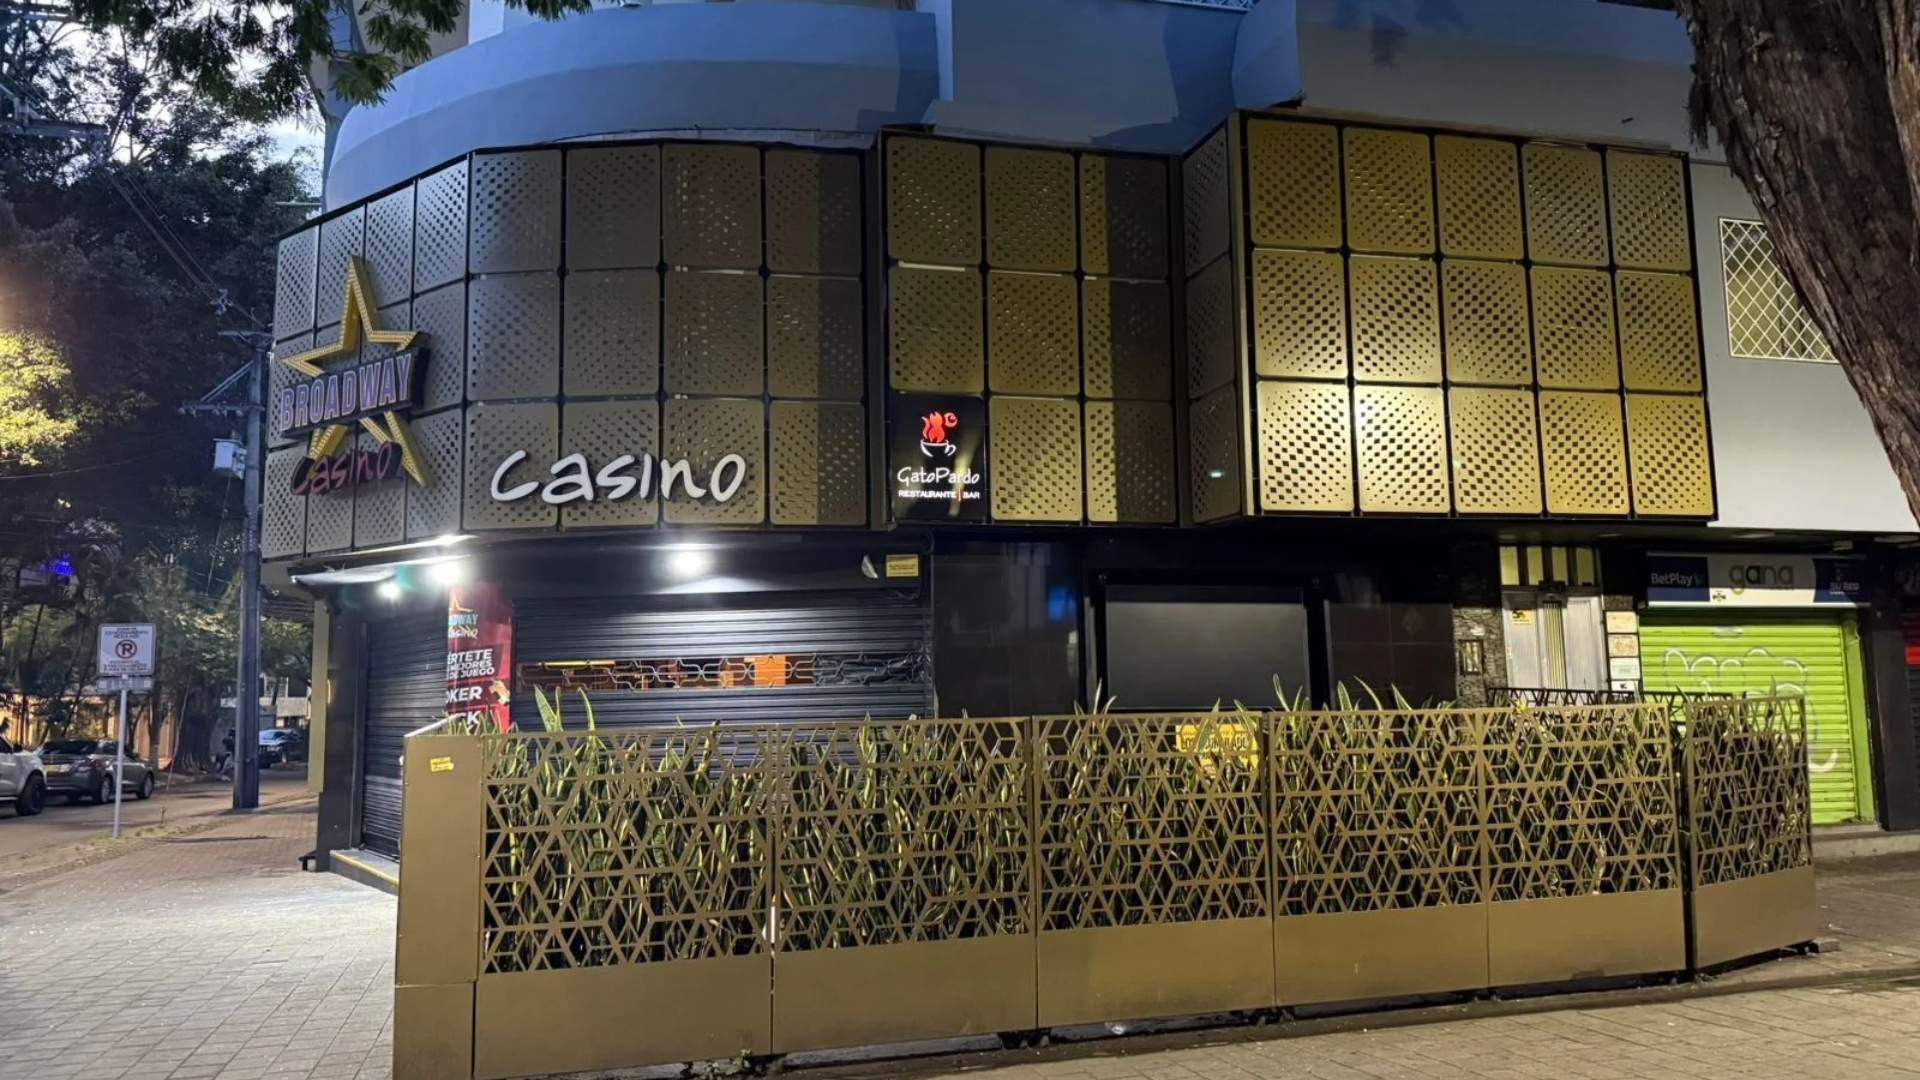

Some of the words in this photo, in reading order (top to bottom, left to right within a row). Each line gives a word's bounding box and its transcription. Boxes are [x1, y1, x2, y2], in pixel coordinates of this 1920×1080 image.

[279, 352, 412, 431] BROADWAY
[491, 450, 746, 504] Casino
[897, 466, 980, 487] GatoPardo
[898, 490, 957, 499] RESTAURANTE
[963, 491, 980, 499] BAR
[1651, 572, 1692, 588] BetPlay
[1729, 565, 1793, 595] gana
